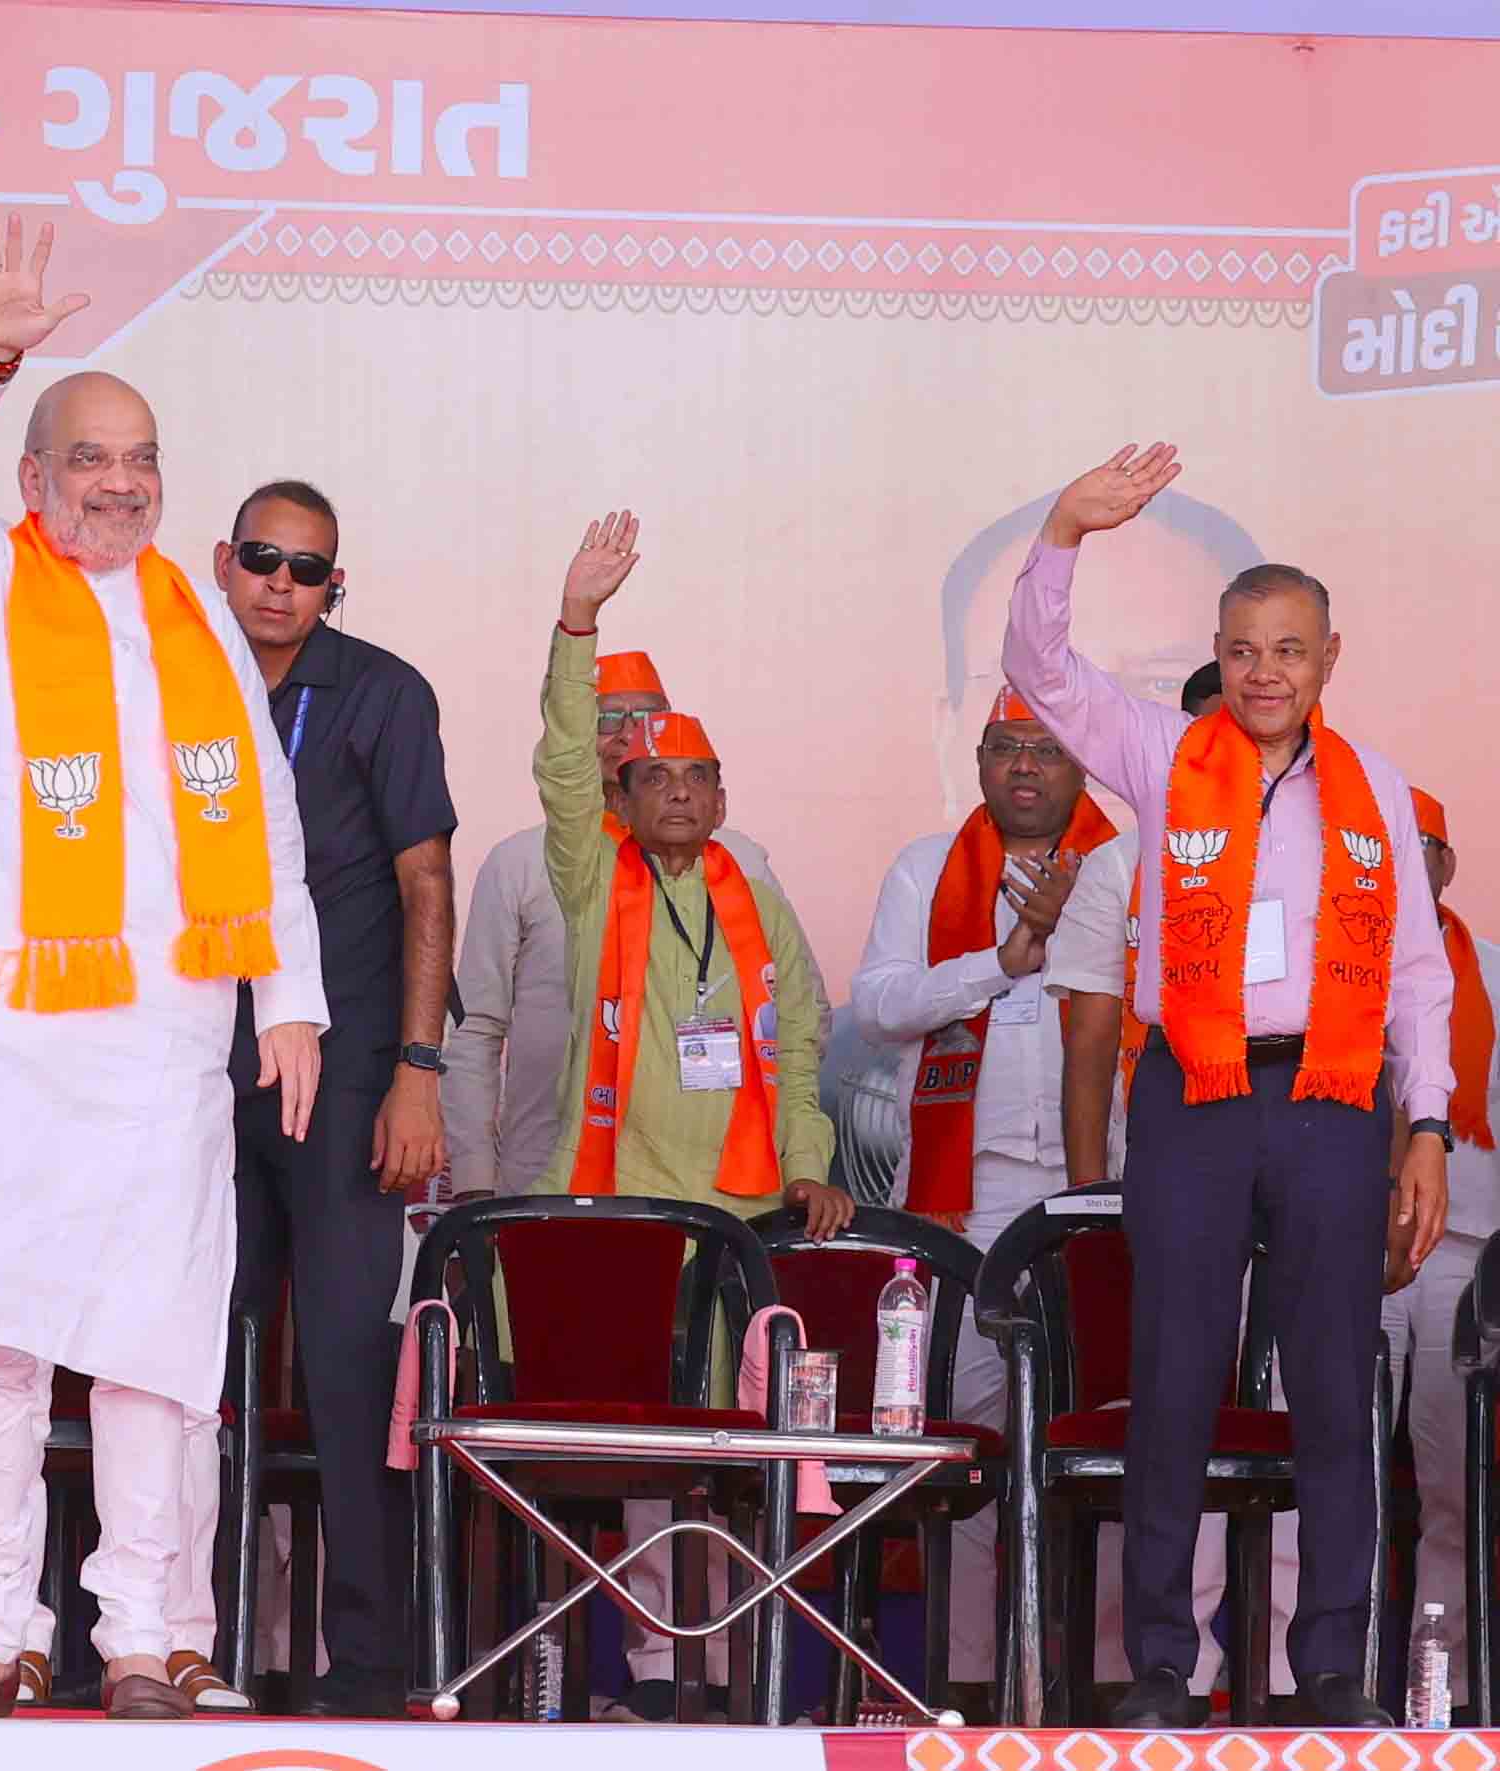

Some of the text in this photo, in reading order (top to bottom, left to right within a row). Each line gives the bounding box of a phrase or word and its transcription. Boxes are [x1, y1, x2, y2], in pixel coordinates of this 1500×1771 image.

[42, 66, 529, 226] ગુજરાત
[1341, 283, 1480, 376] મોદી
[1328, 959, 1384, 992] ભાજપ
